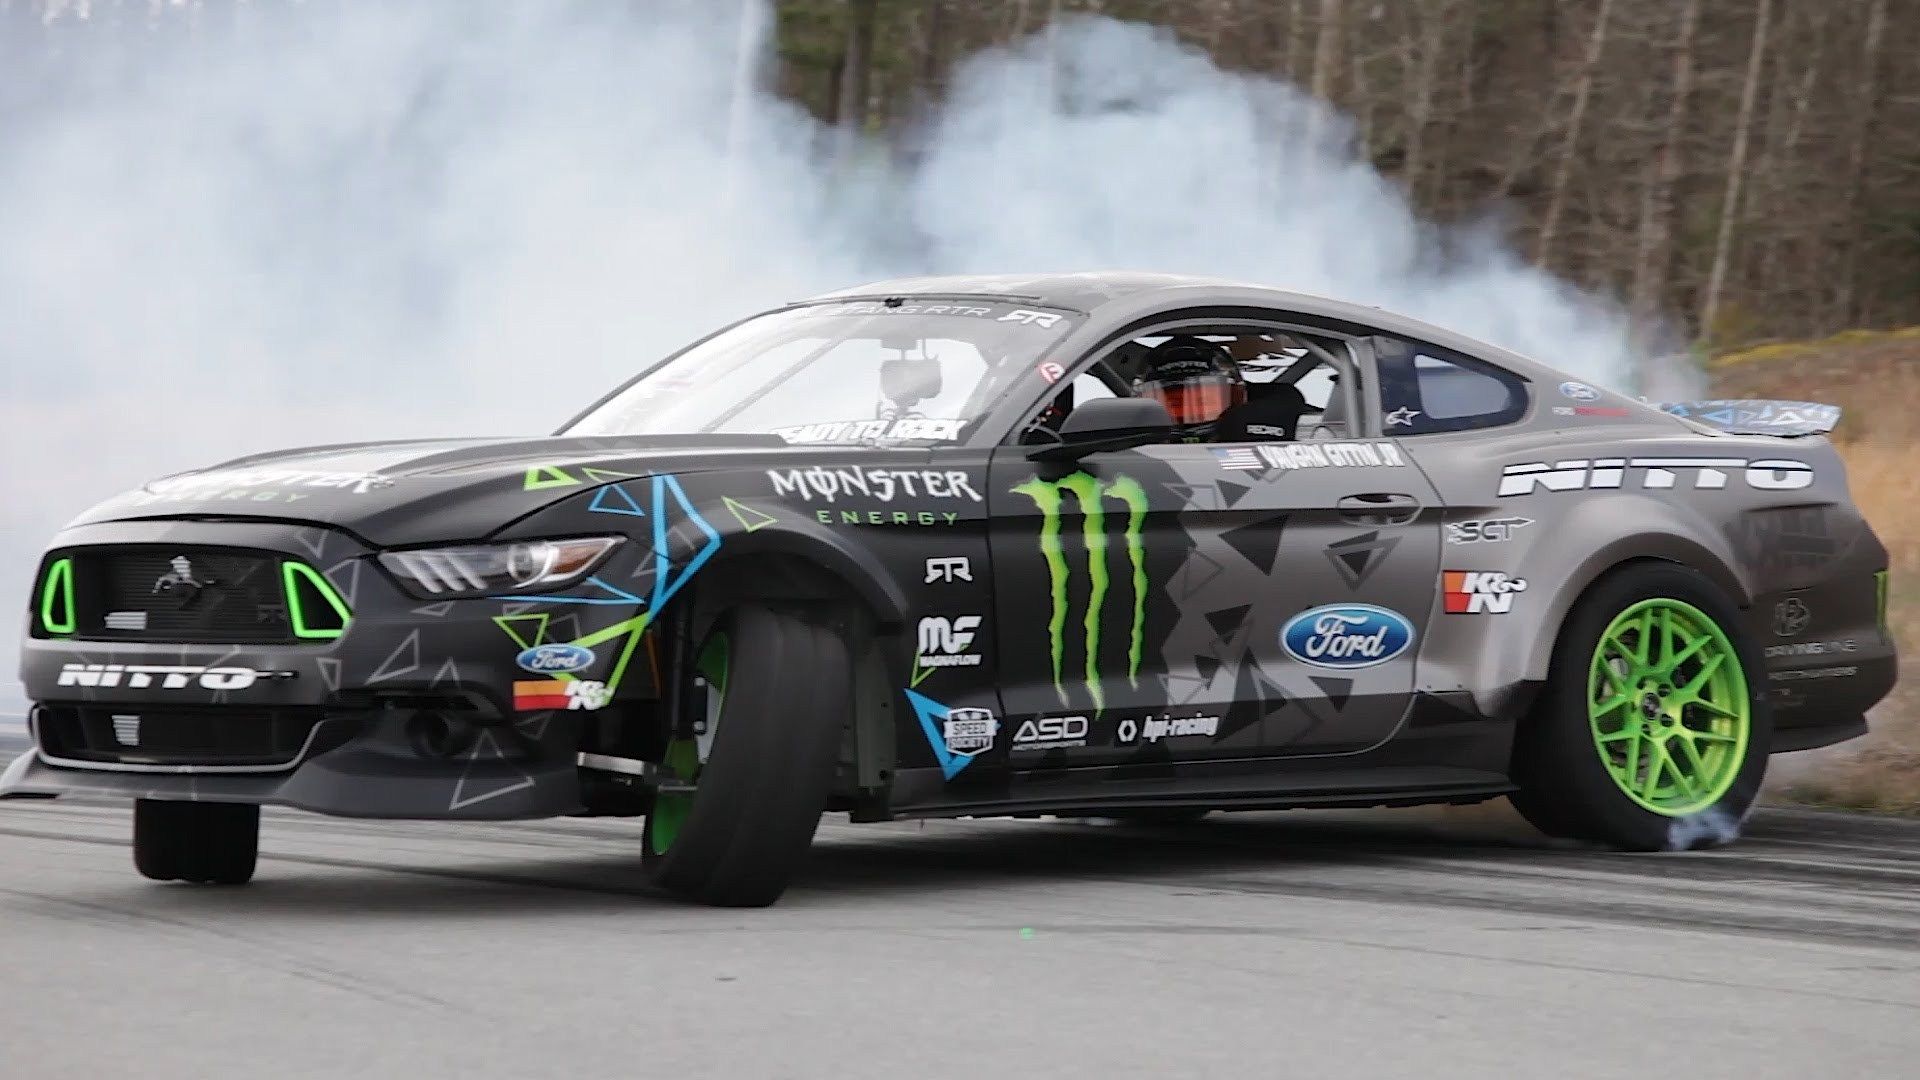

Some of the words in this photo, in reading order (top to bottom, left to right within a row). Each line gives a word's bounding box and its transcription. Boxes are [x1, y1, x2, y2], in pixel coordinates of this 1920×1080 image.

[922, 306, 991, 316] RTR
[1497, 457, 1815, 497] NITTO
[816, 510, 960, 526] ENERGY
[1305, 613, 1389, 658] Ford
[57, 663, 256, 689] NITTO
[953, 722, 987, 735] SPEED
[950, 736, 990, 749] SOCIETY
